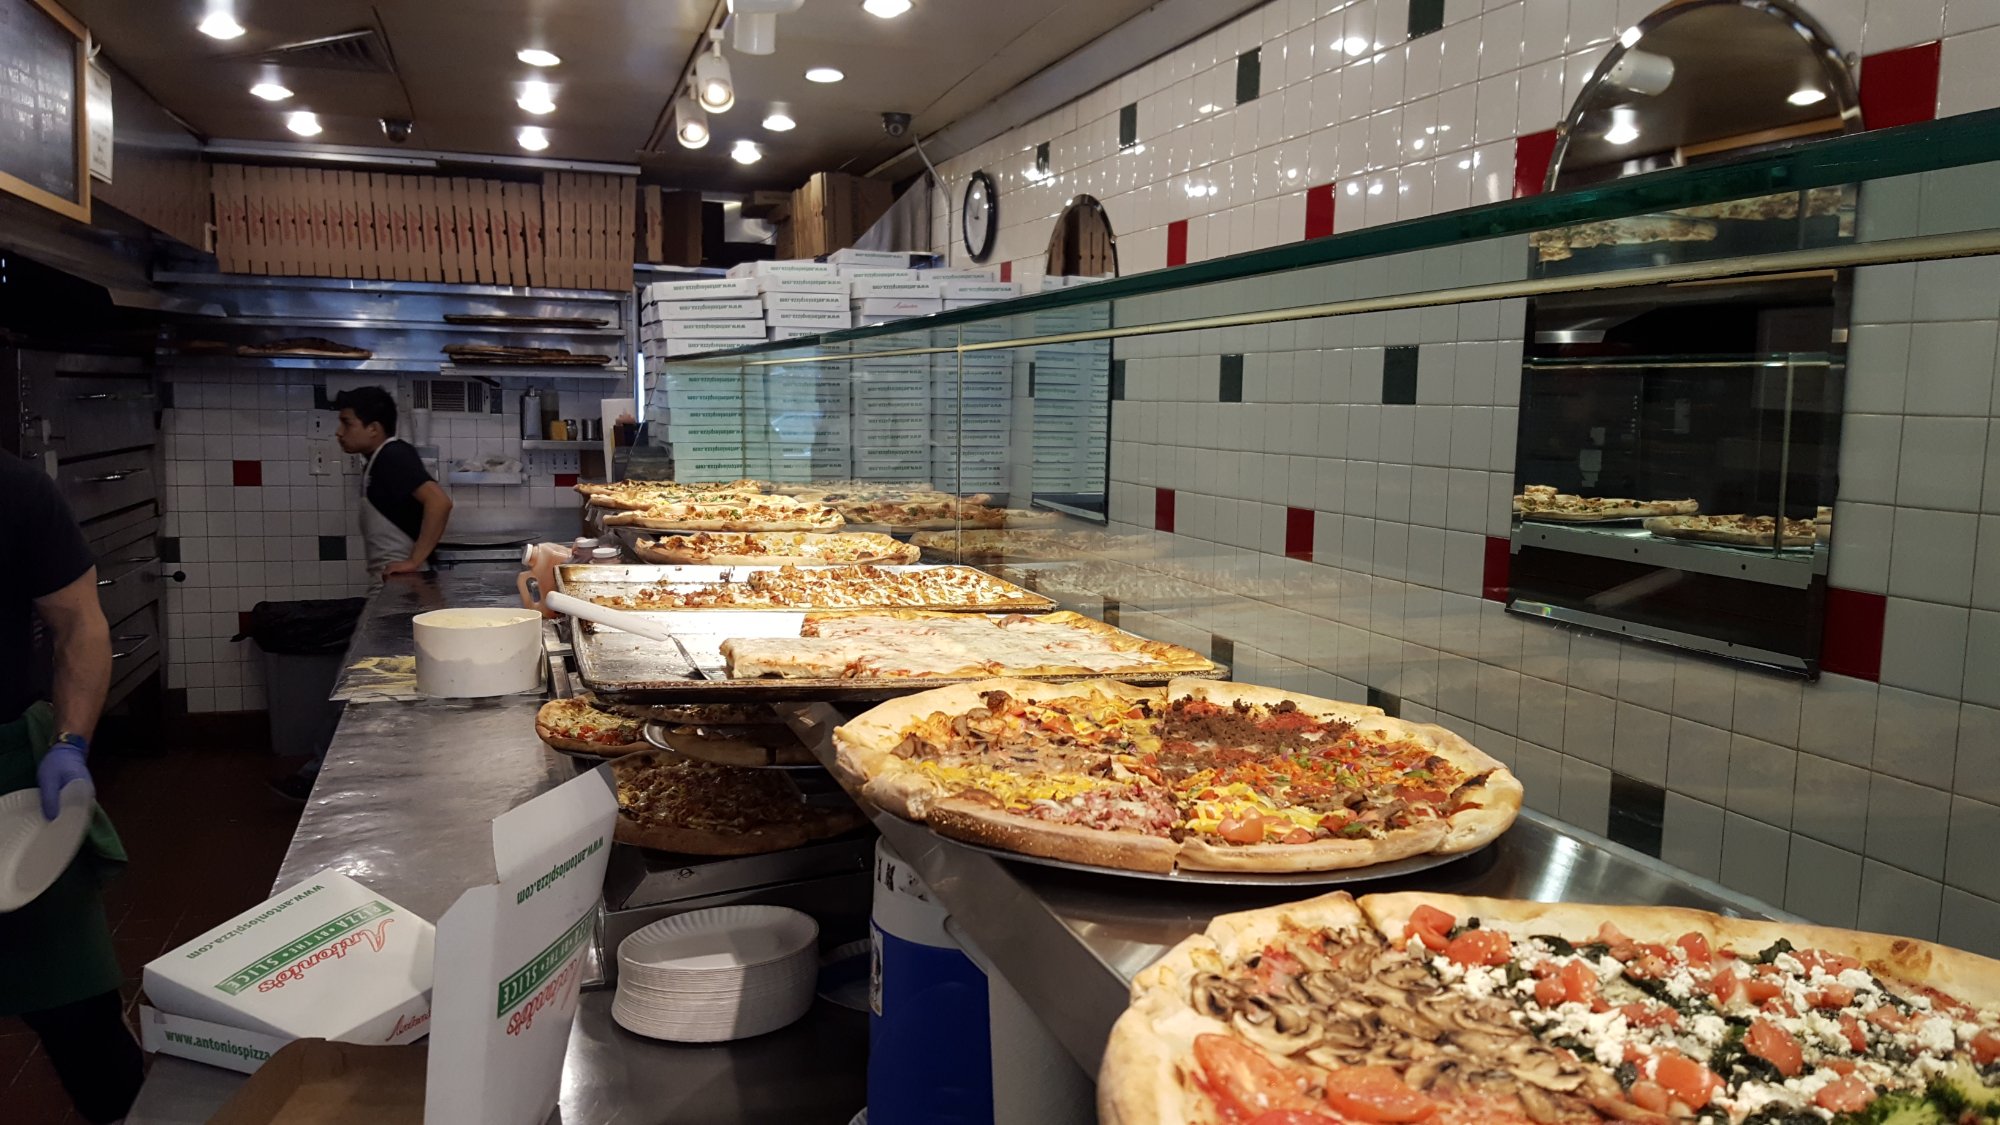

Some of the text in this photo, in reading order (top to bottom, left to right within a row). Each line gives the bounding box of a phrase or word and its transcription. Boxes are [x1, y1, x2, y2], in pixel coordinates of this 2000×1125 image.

[517, 836, 603, 904] www.antoniospizza.com
[186, 885, 325, 960] www.antoniospizza.com
[226, 905, 384, 991] PIZZA BY THE SLICE
[574, 914, 593, 944] IZZA
[258, 918, 394, 993] Antonio's
[545, 948, 558, 969] THE
[504, 964, 538, 1004] SLICE
[164, 1030, 271, 1062] www.antoniospizza
